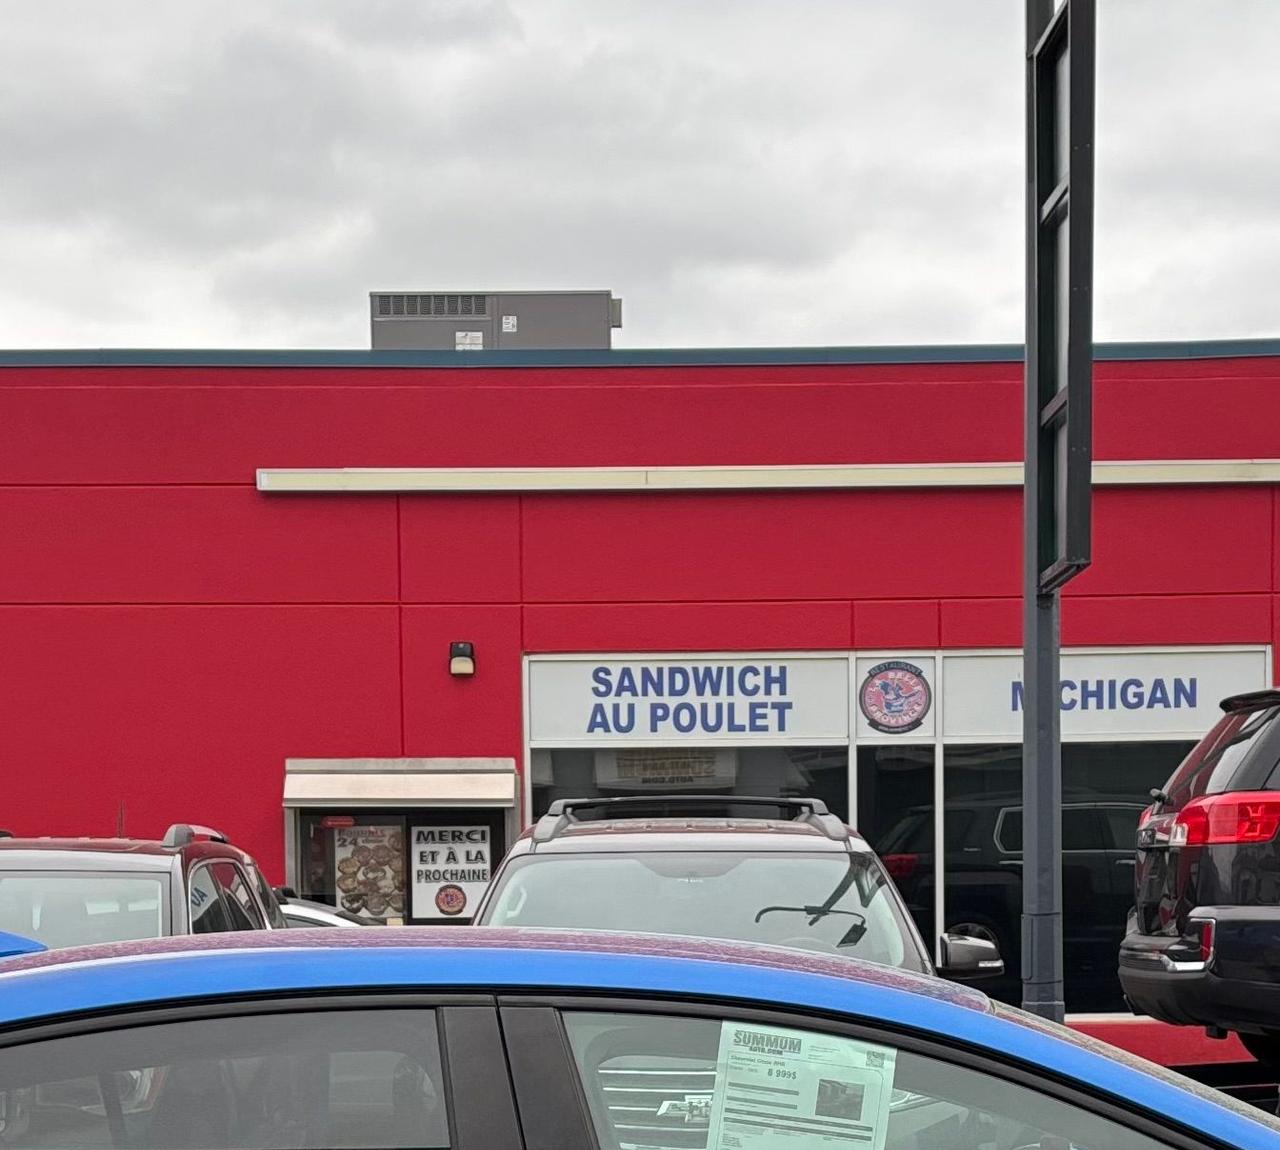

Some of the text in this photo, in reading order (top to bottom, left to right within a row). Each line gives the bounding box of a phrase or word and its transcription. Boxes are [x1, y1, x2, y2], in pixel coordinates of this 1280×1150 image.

[591, 665, 788, 698] SANDWICH
[1011, 677, 1198, 712] CHIGAN
[586, 701, 793, 734] AU POULET
[415, 829, 488, 844] MERCI
[419, 846, 487, 865] ET À LA
[416, 868, 489, 883] PROCHAINE
[733, 1030, 802, 1053] SUMMUM
